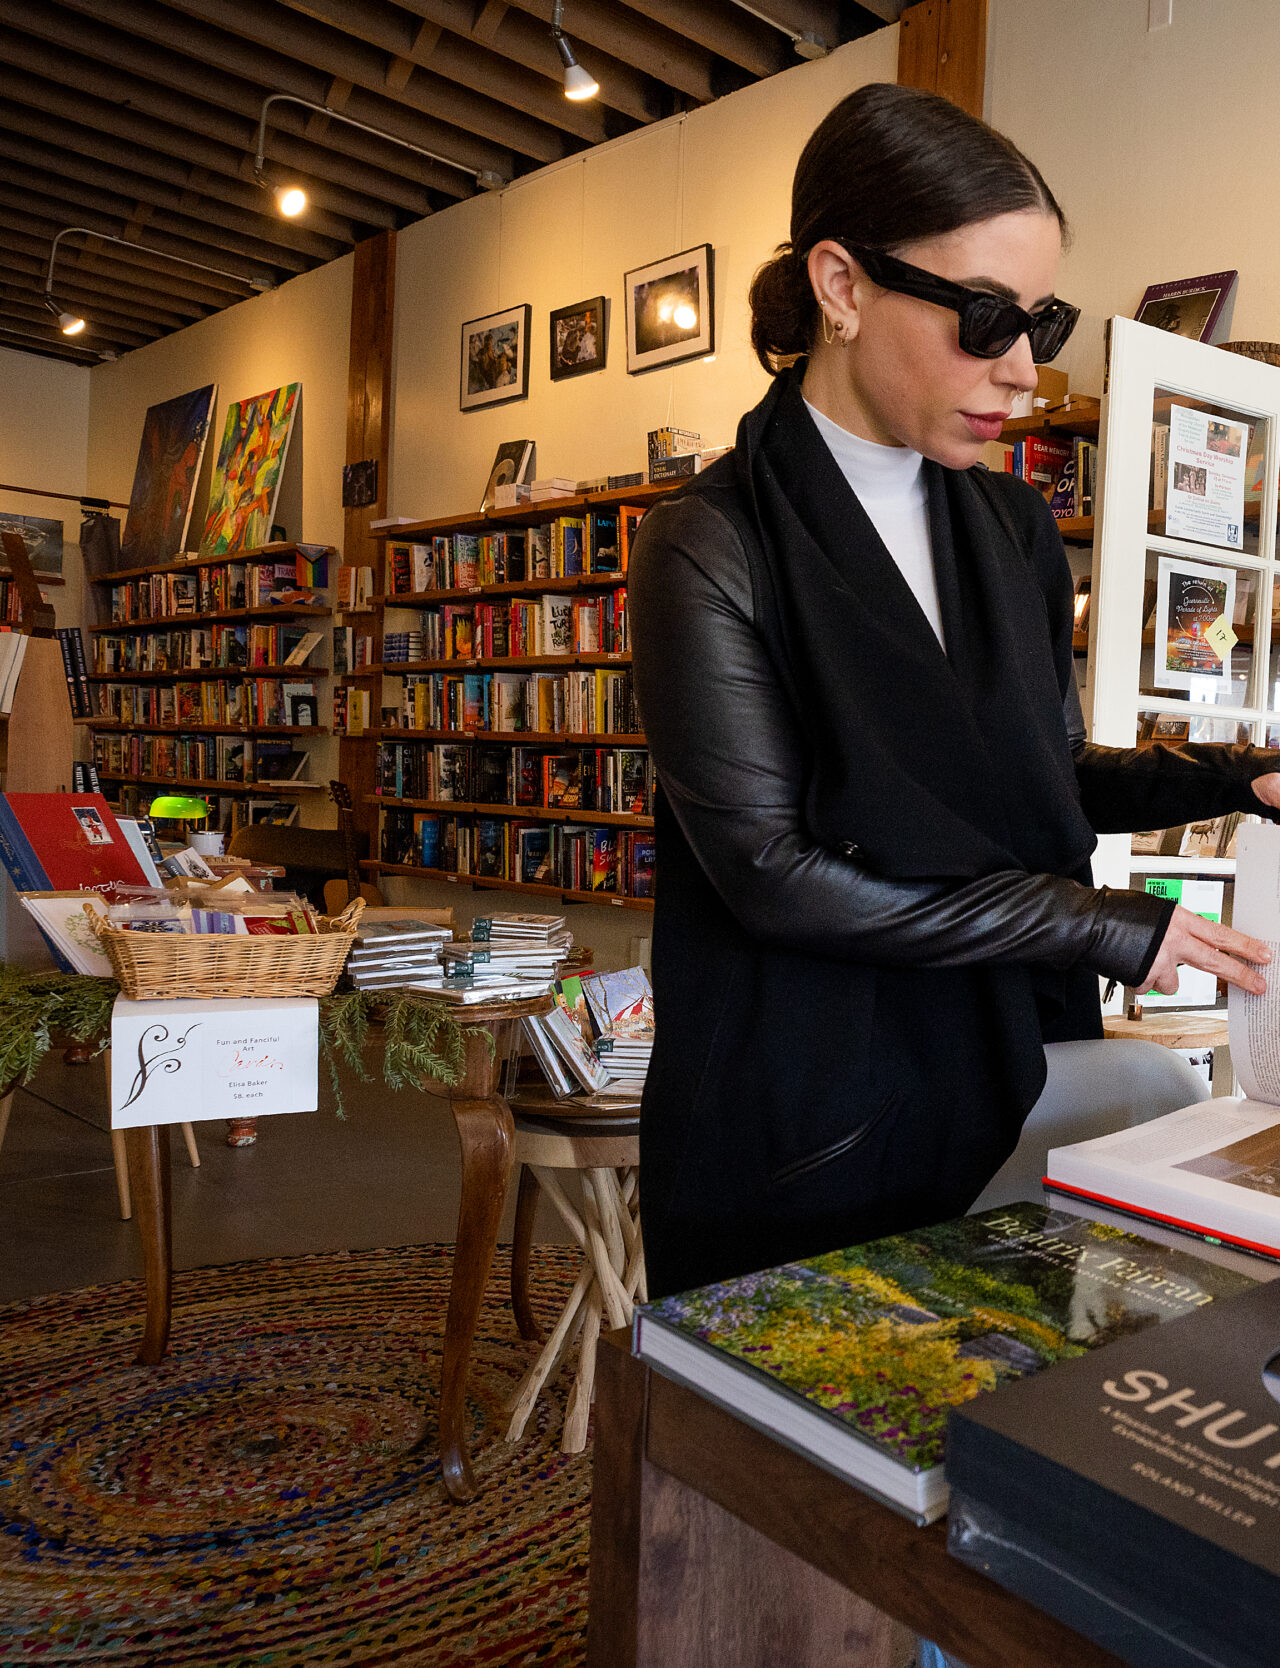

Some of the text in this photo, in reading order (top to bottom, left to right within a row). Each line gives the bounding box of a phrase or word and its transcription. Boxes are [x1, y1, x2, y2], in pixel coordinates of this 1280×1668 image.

[1033, 443, 1049, 452] DEAR
[1149, 885, 1168, 896] LEGAL
[249, 1036, 280, 1044] Fanciful
[981, 1216, 1099, 1264] Beatrix
[1111, 1422, 1199, 1470] Extraordinary
[1199, 1463, 1280, 1508] Spaceflight
[1131, 1461, 1257, 1528] ROLAND MILLER
